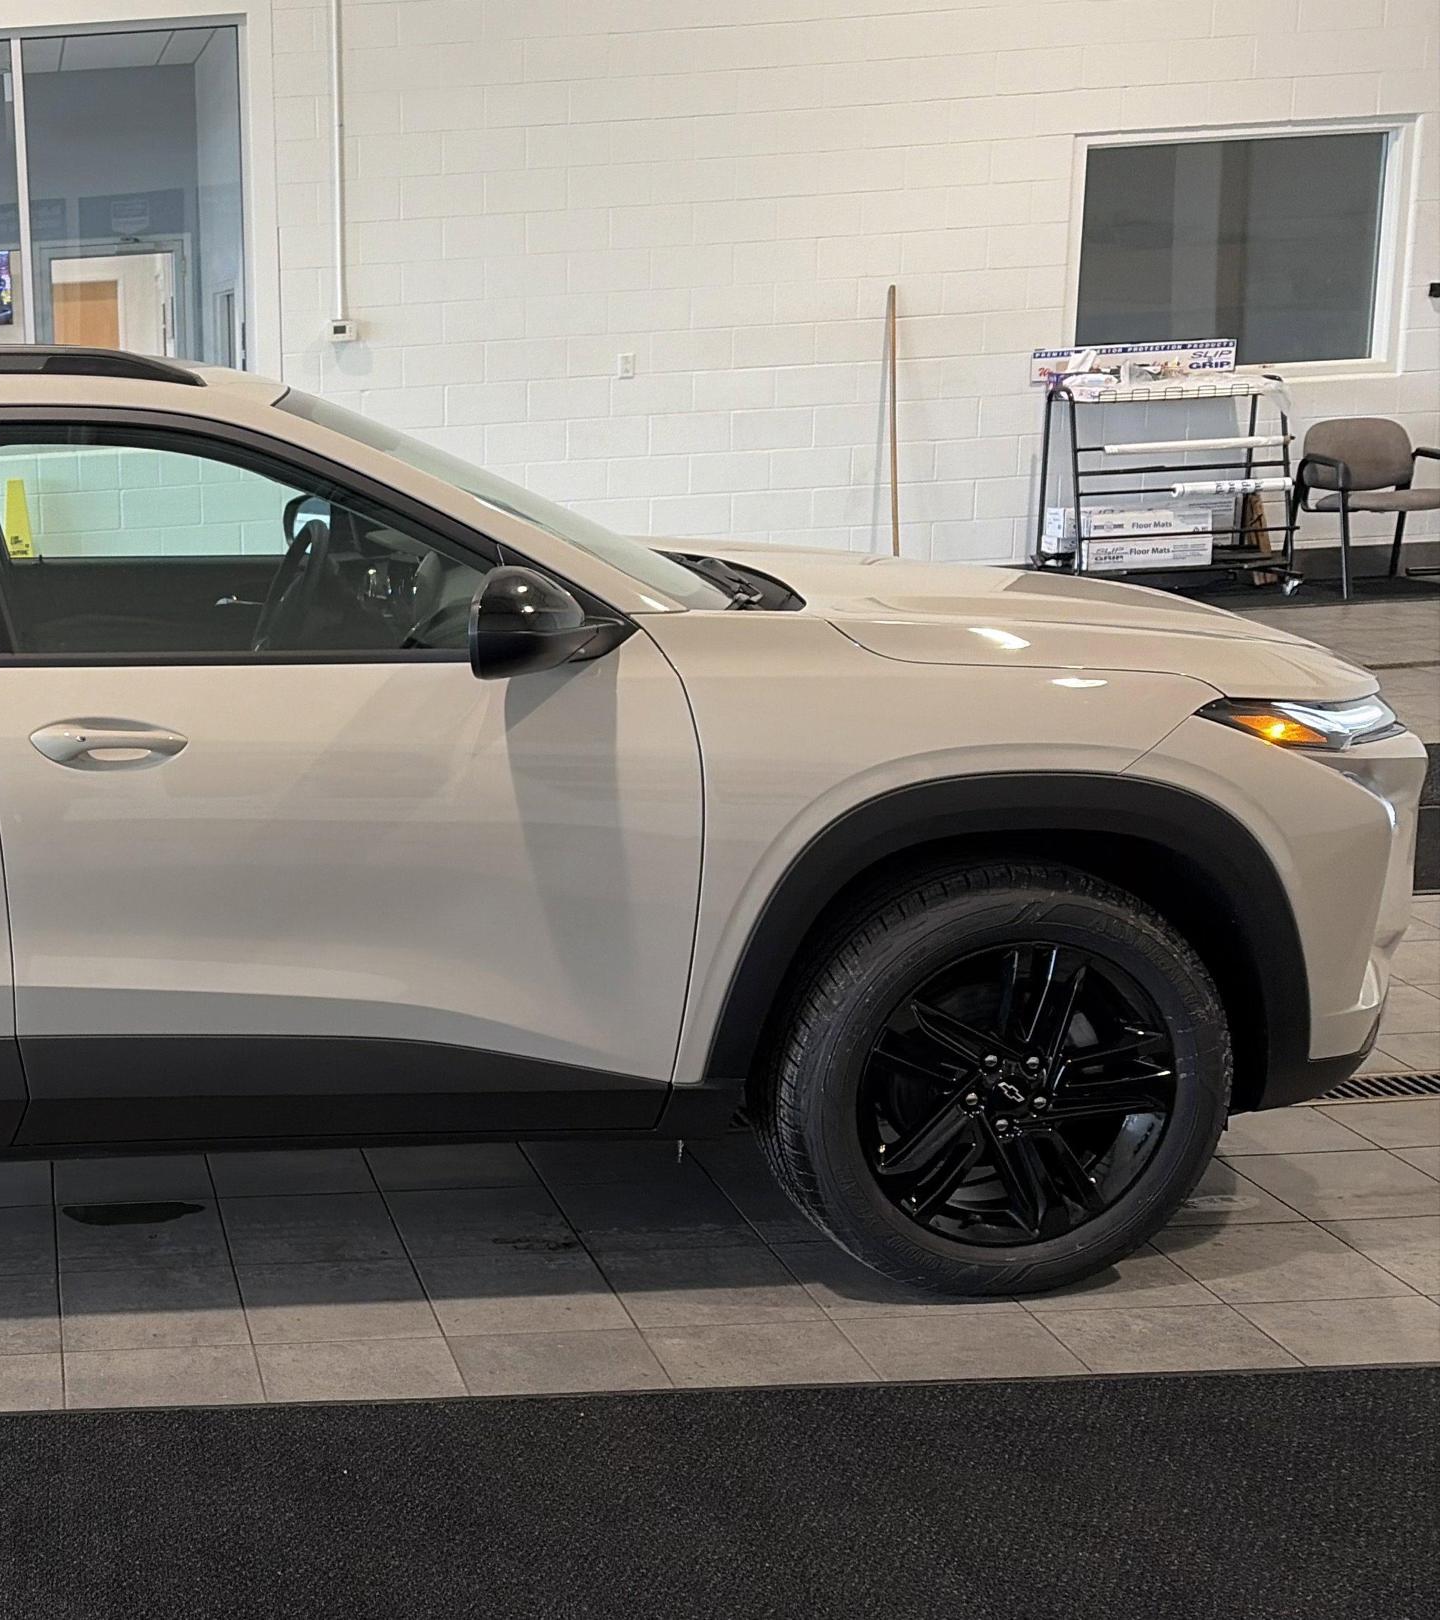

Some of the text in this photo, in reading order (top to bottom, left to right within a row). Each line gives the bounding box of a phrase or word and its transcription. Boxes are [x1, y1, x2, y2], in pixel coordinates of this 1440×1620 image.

[1127, 344, 1182, 352] PROTECTION
[1191, 350, 1232, 359] SLIP
[1189, 361, 1231, 370] GRIP
